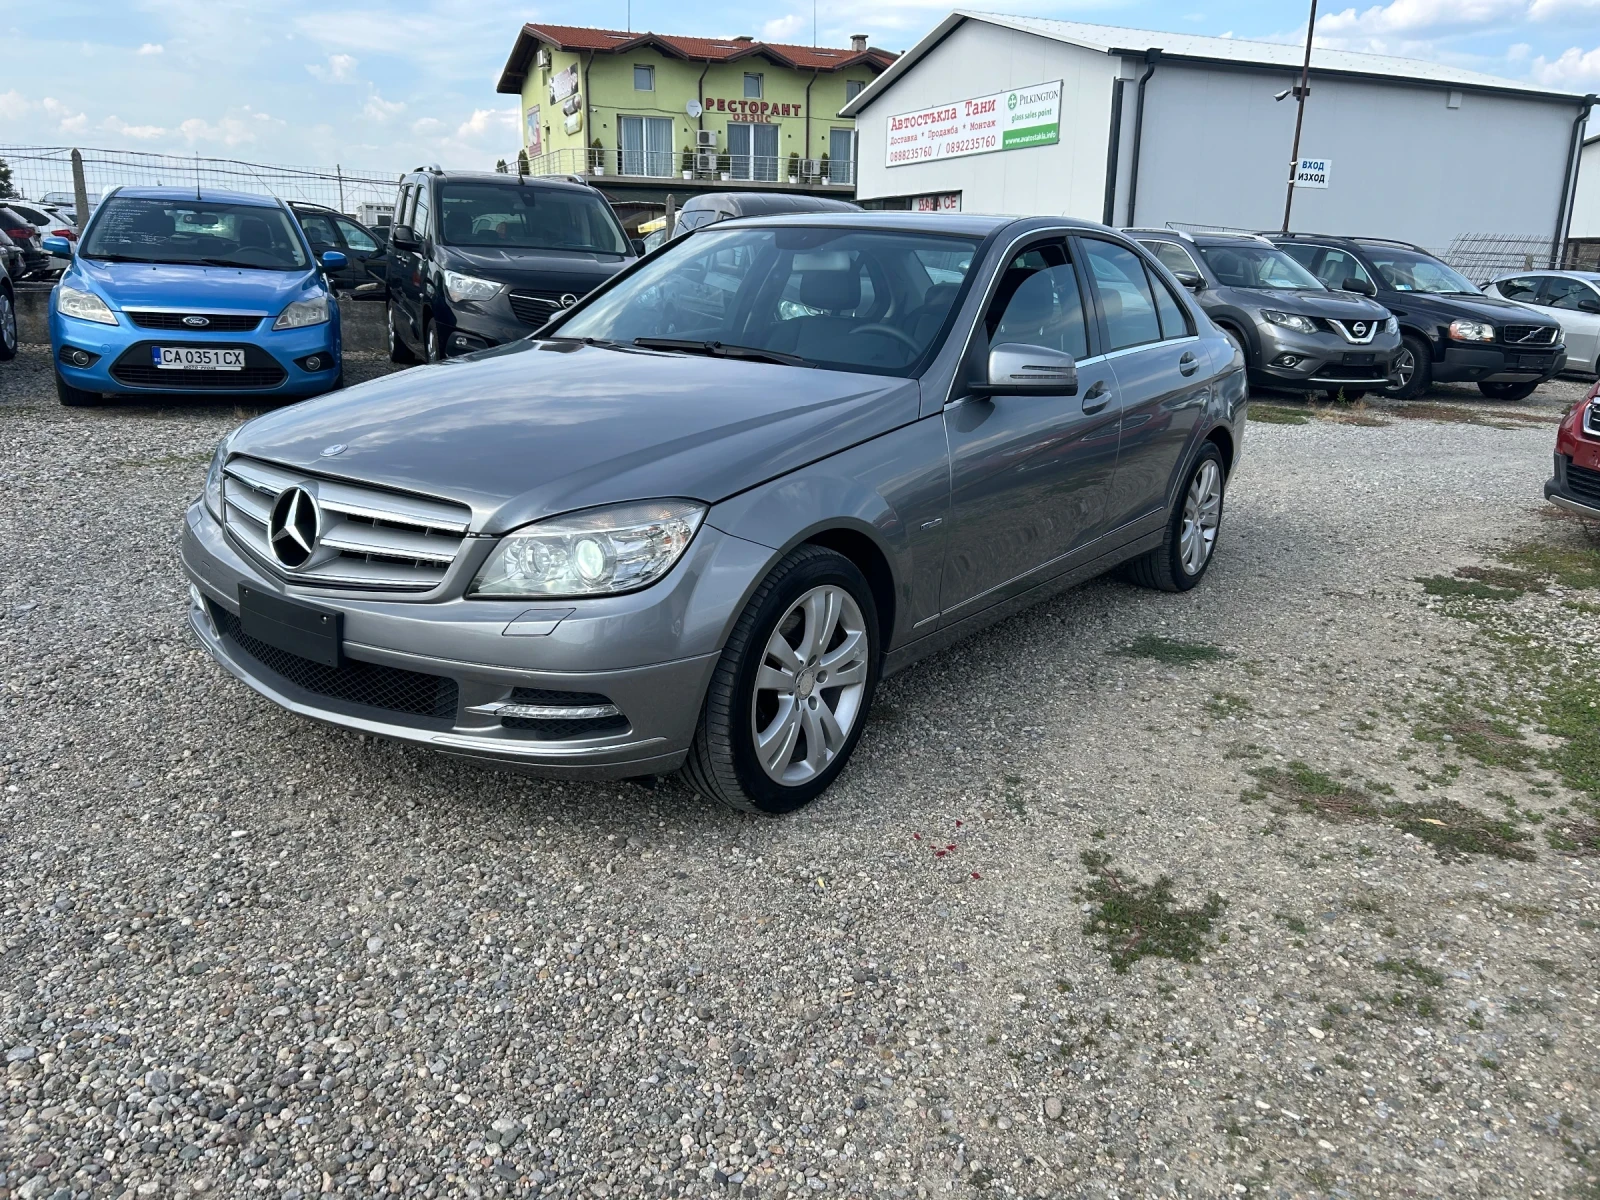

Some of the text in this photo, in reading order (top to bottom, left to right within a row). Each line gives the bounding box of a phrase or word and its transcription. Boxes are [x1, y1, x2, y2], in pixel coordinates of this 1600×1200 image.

[1020, 90, 1059, 105] PILKINGTON
[705, 97, 801, 116] РЕСТОРАНТ
[891, 99, 996, 131] Автостъкла Тани
[1011, 108, 1052, 124] glass sales point
[890, 120, 996, 146] Доставка Продажба Монтаж
[946, 135, 996, 153] 0892235760
[1302, 161, 1325, 171] ВХОД
[1298, 173, 1325, 183] ИЗХОД
[944, 194, 957, 209] СЕ
[163, 350, 242, 365] CA 0351 CX
